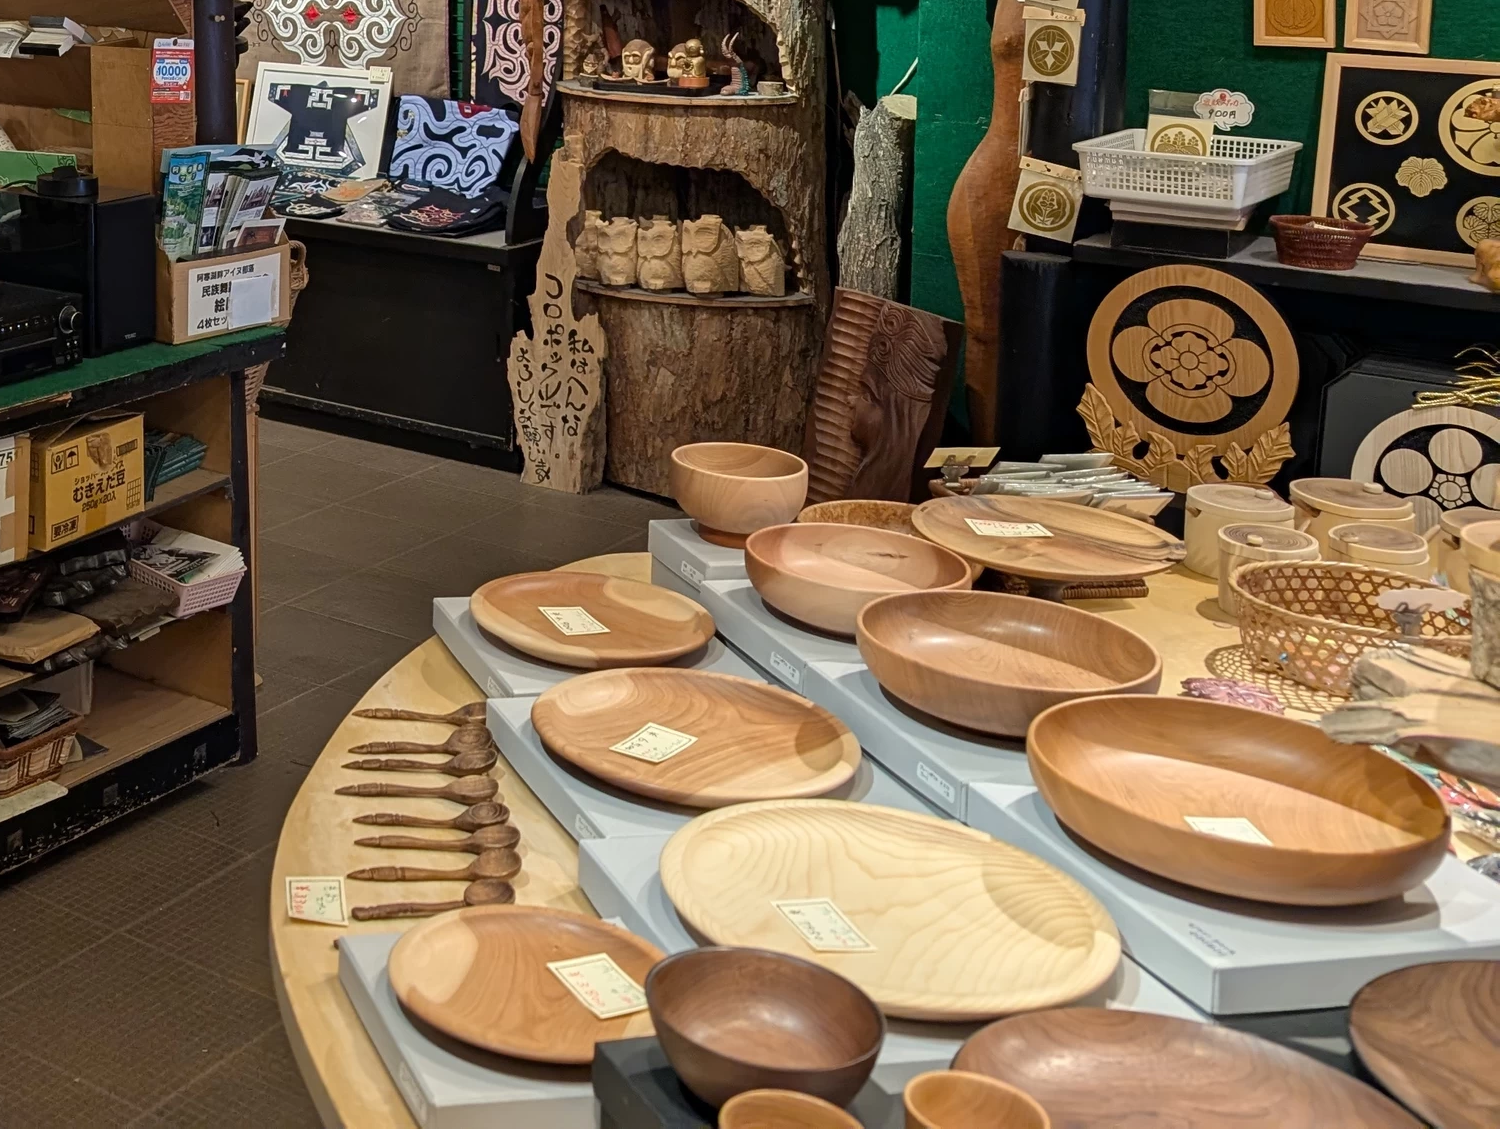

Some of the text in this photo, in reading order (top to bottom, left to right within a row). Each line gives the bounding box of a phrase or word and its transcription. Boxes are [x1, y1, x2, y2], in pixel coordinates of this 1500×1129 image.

[72, 468, 126, 504] むきえだ豆
